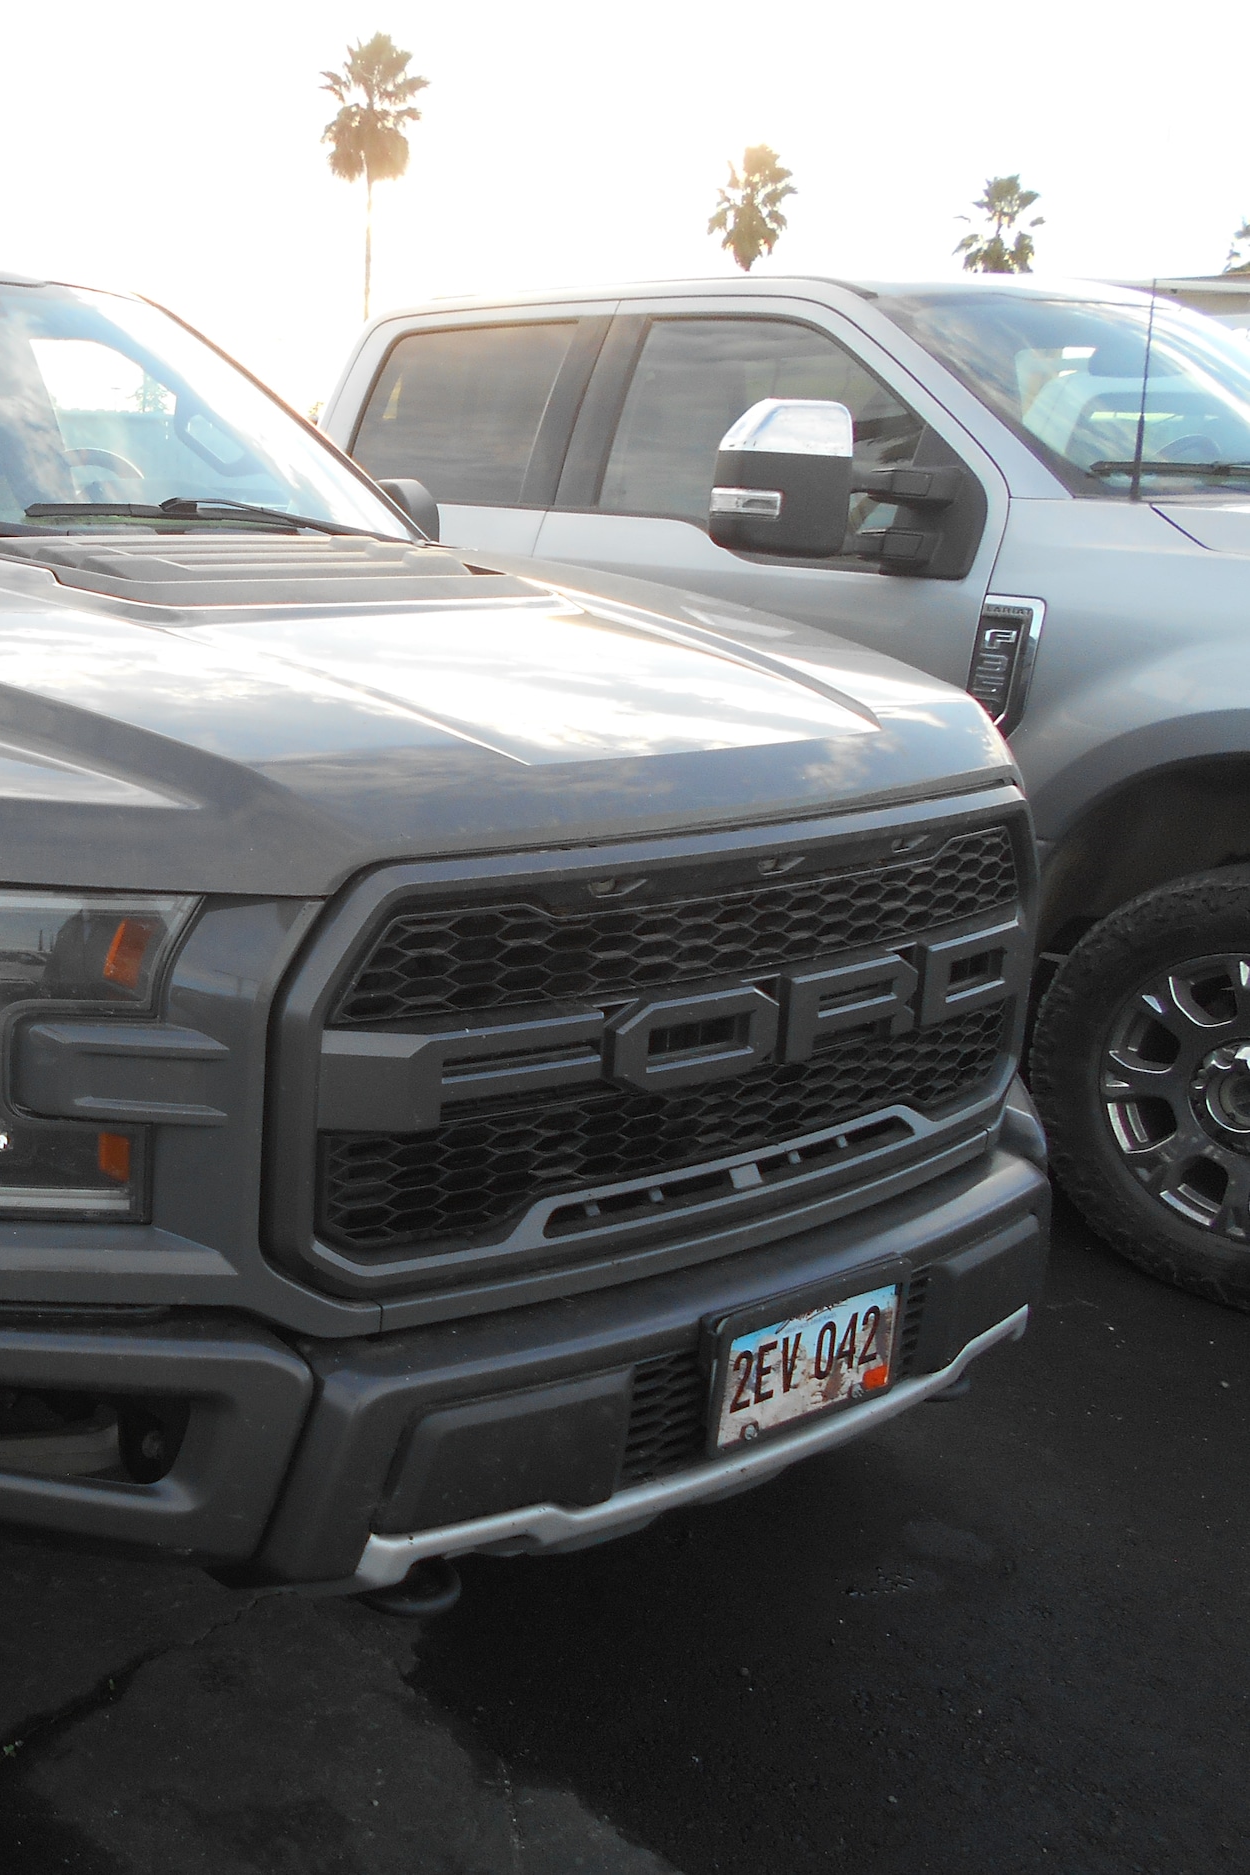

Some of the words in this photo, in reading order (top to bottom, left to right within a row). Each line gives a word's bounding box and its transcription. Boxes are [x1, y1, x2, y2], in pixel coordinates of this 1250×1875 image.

[986, 605, 1032, 615] LARIAT
[322, 919, 1018, 1131] FORD
[731, 1332, 802, 1413] 2EV
[815, 1305, 881, 1380] 042
